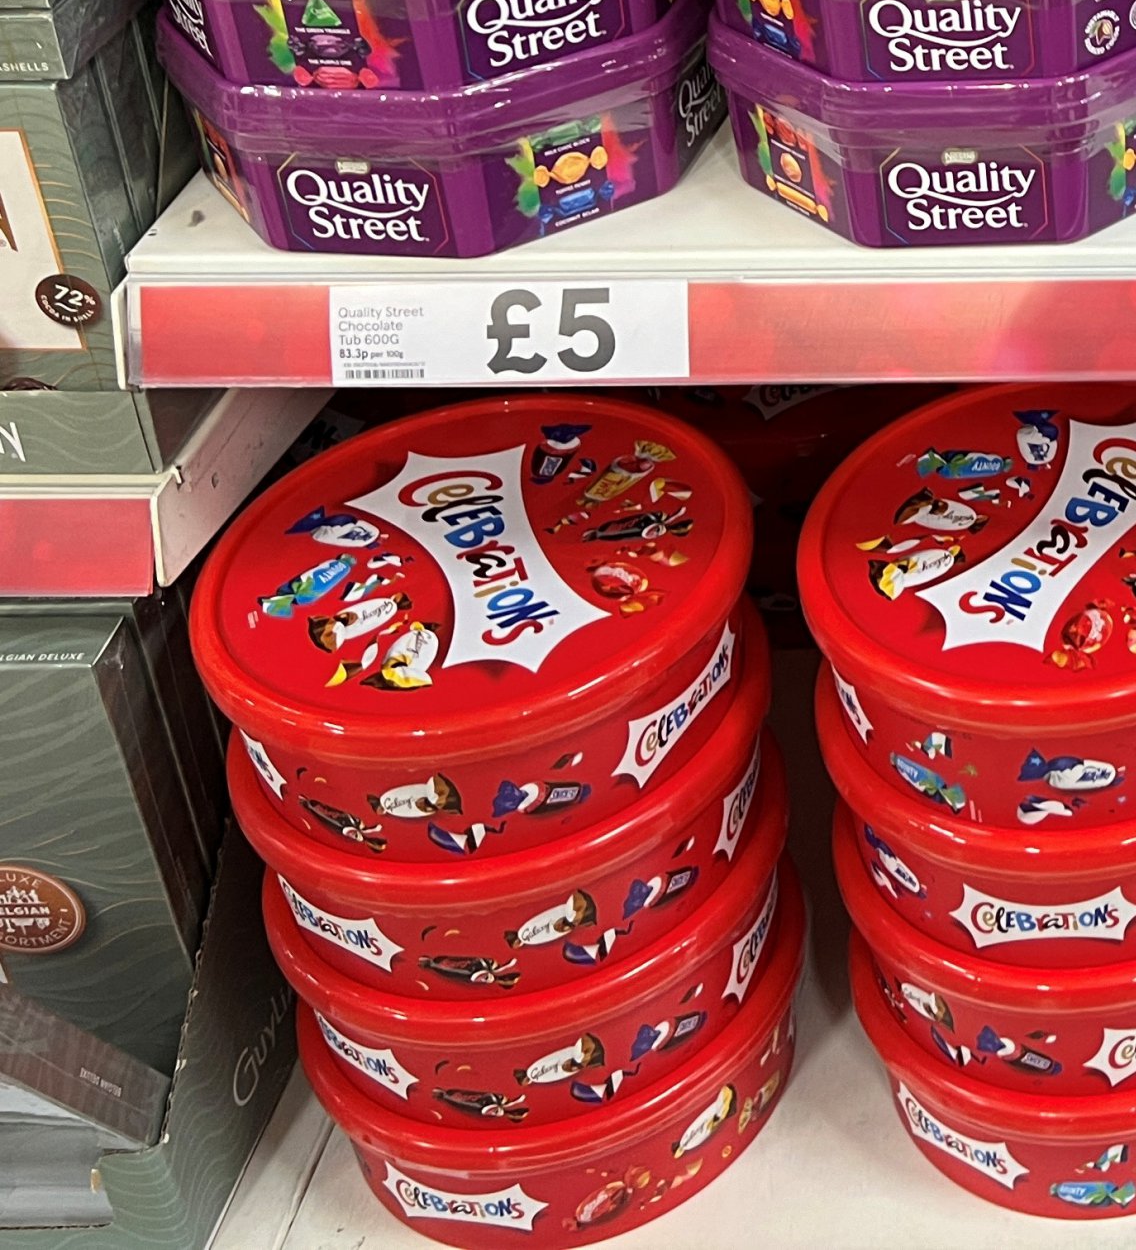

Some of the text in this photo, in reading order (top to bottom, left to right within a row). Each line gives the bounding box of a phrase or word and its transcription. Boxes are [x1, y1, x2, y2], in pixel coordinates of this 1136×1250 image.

[486, 16, 608, 69] Street
[889, 37, 1014, 73] Street
[0, 61, 50, 73] SHELLS
[287, 168, 429, 220] Quality
[888, 161, 1036, 208] Quality
[310, 208, 430, 244] Street
[907, 197, 1029, 231] Street
[54, 283, 97, 308] 72%
[338, 306, 425, 321] Quality Street
[338, 320, 404, 332] Chocolate
[339, 333, 400, 345] Tub 600G
[486, 287, 616, 375] £5
[339, 348, 404, 361] 83.3p per 100g
[38, 652, 85, 662] DELUXE
[0, 917, 72, 947] ORTMENT
